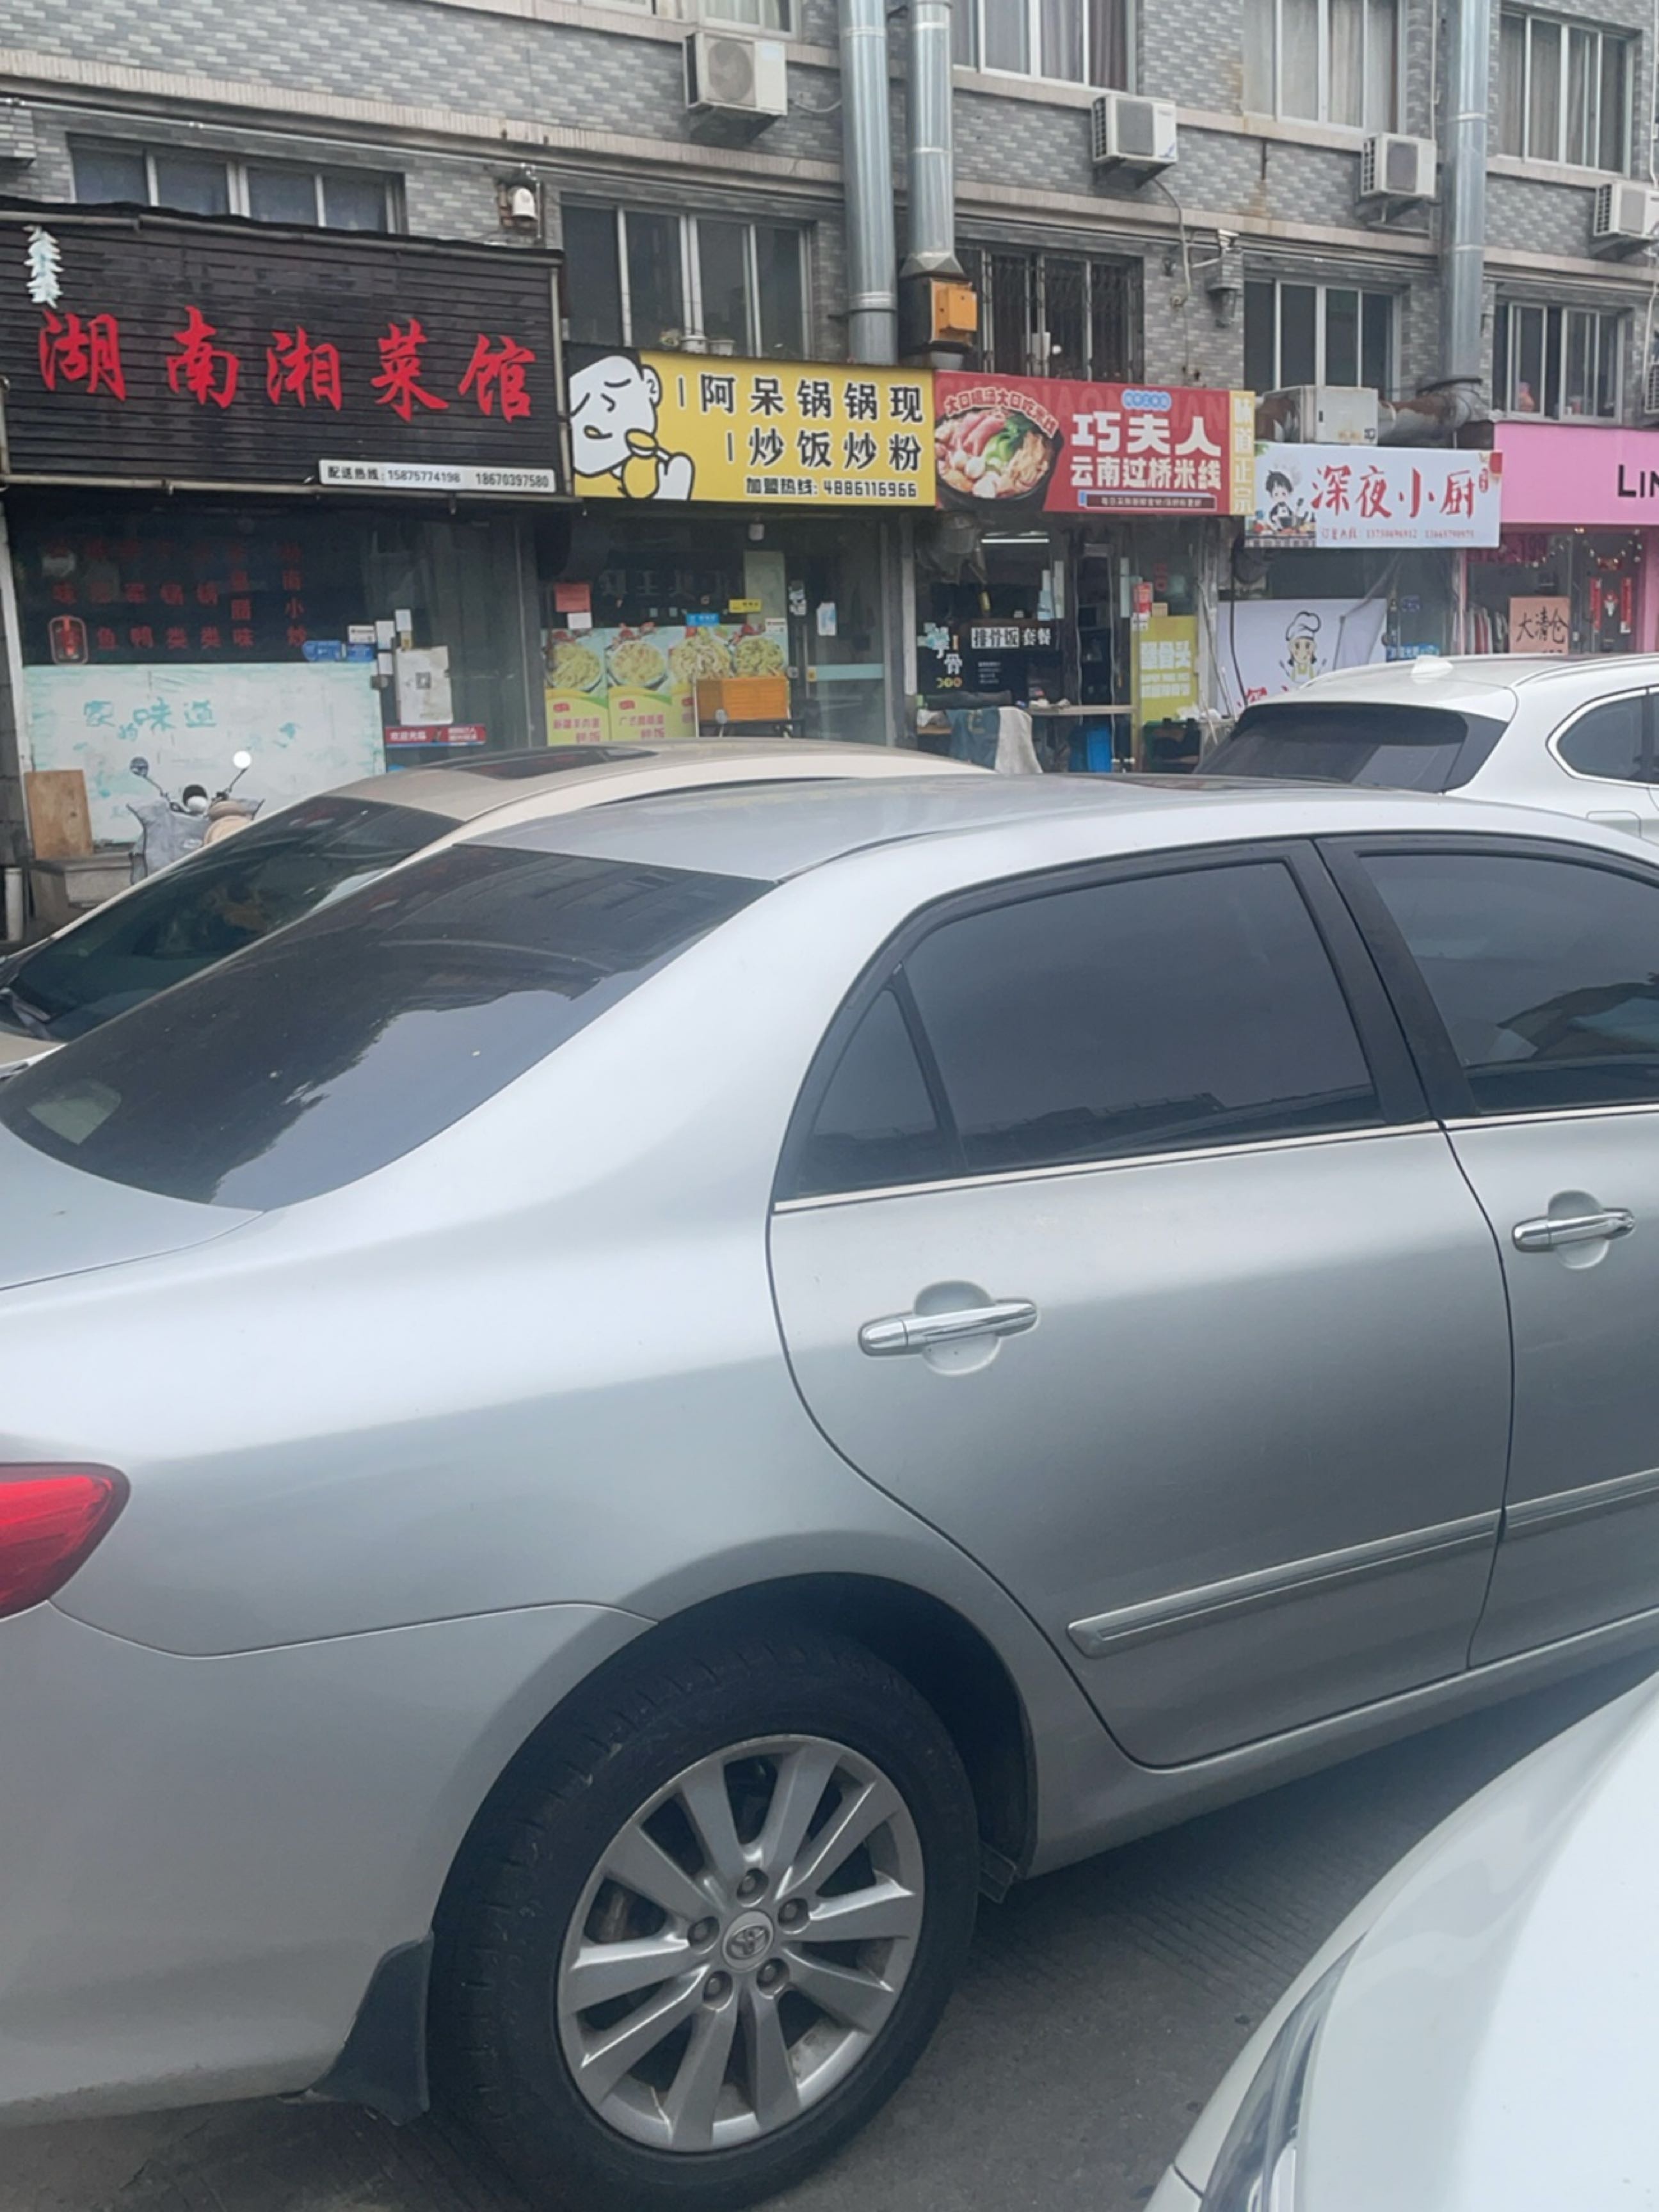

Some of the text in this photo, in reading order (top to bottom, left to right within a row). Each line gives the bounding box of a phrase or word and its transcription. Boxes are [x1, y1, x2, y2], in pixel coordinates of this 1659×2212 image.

[38, 304, 537, 423] 湖南湘菜馆
[700, 374, 923, 424] 阿呆锅锅现
[749, 427, 922, 471] 炒饭炒粉
[1071, 410, 1222, 457] 巧夫人
[823, 479, 917, 497] 4886116966
[1070, 455, 1222, 491] 云南过桥米线
[1310, 465, 1475, 519] 深夜小厨
